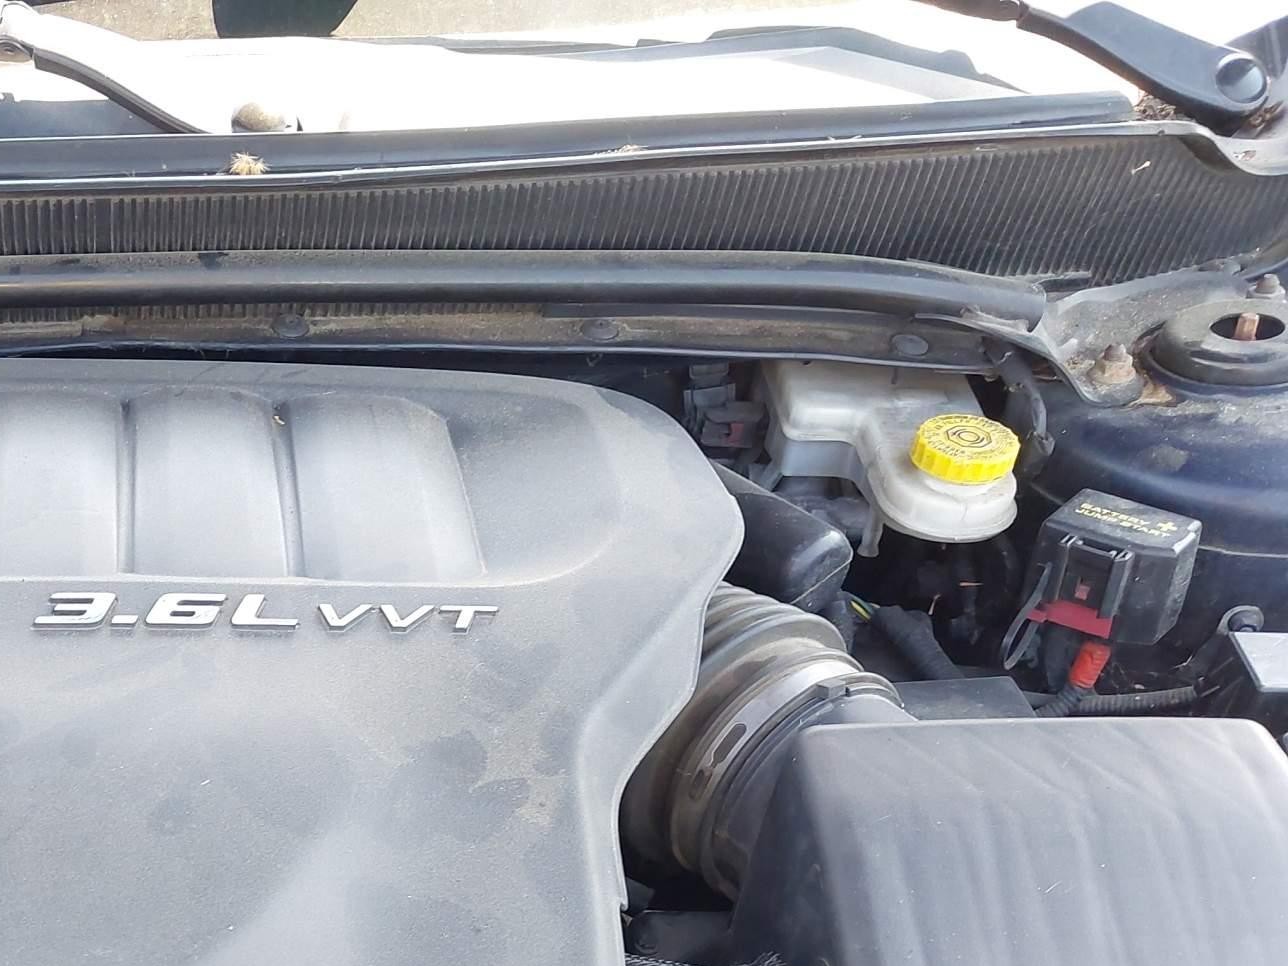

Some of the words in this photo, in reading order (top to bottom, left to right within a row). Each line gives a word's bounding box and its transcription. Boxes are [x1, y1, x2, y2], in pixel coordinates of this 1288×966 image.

[1075, 508, 1118, 522] JUMP
[1119, 520, 1171, 538] START
[1080, 502, 1151, 525] BATTERY
[31, 592, 300, 630] 3.6L
[318, 602, 499, 634] VVT
